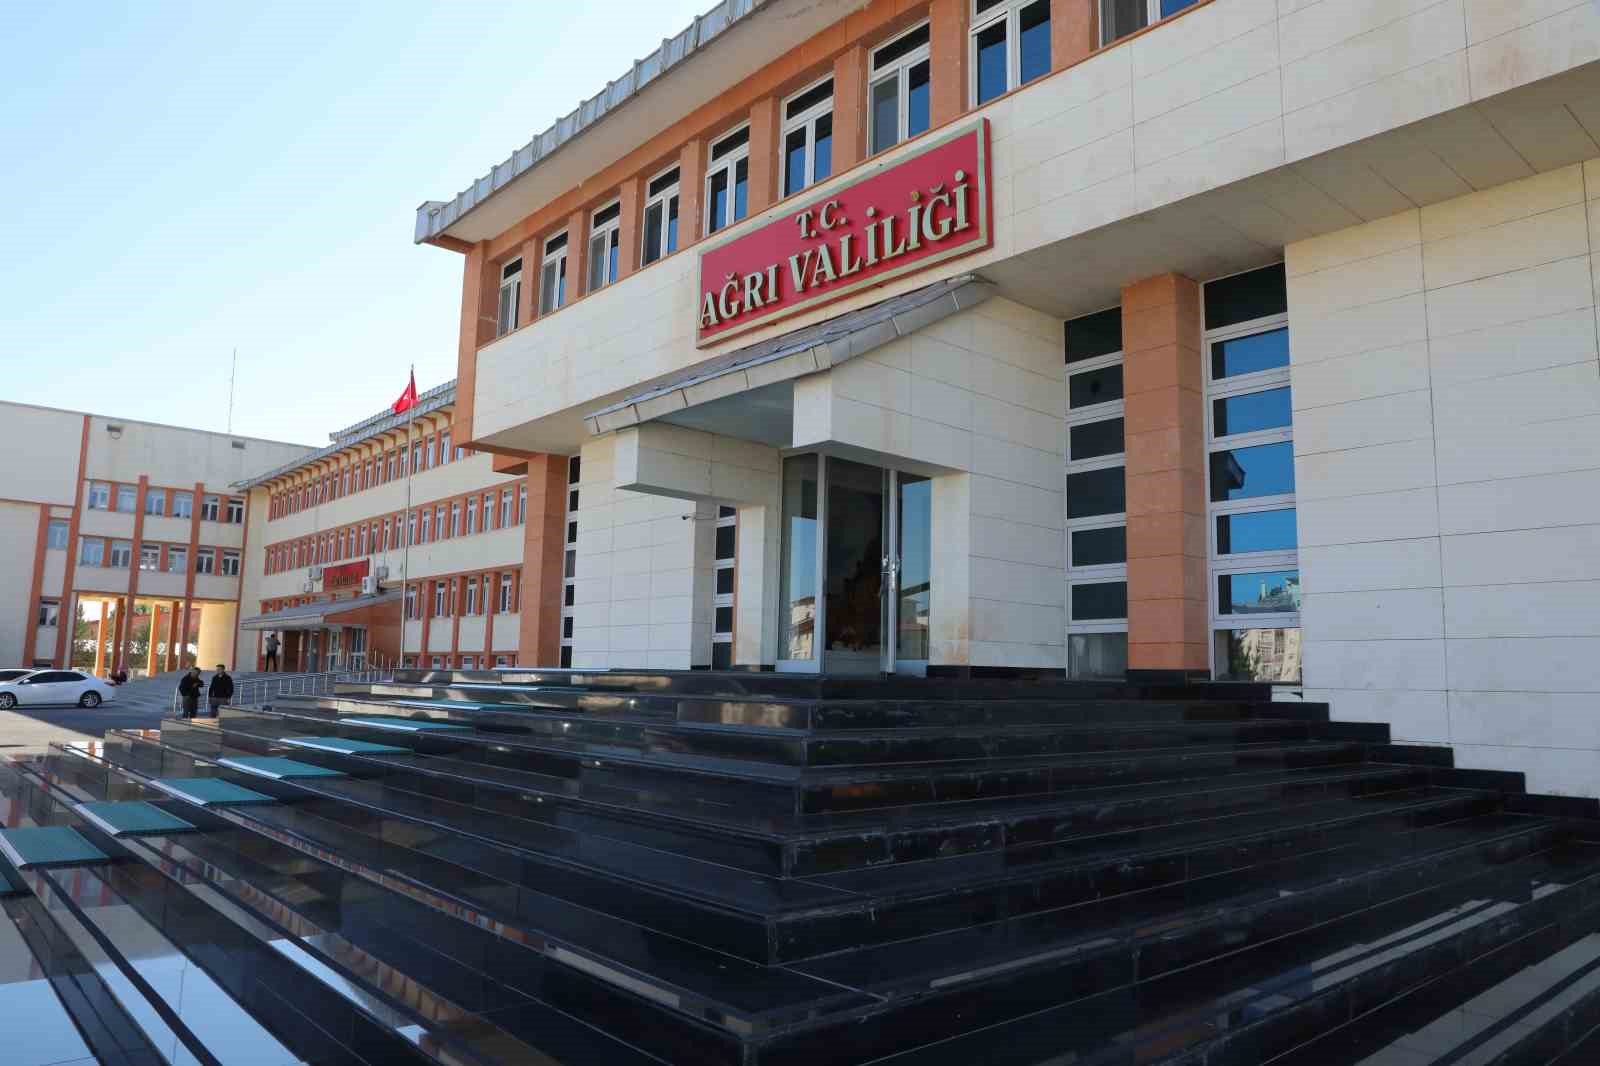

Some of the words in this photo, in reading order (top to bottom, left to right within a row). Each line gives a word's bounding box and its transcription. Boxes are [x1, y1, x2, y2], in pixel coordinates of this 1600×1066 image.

[700, 263, 780, 329] AĞRI
[788, 169, 970, 293] VALİLİĞİ
[796, 200, 848, 239] T.C.
